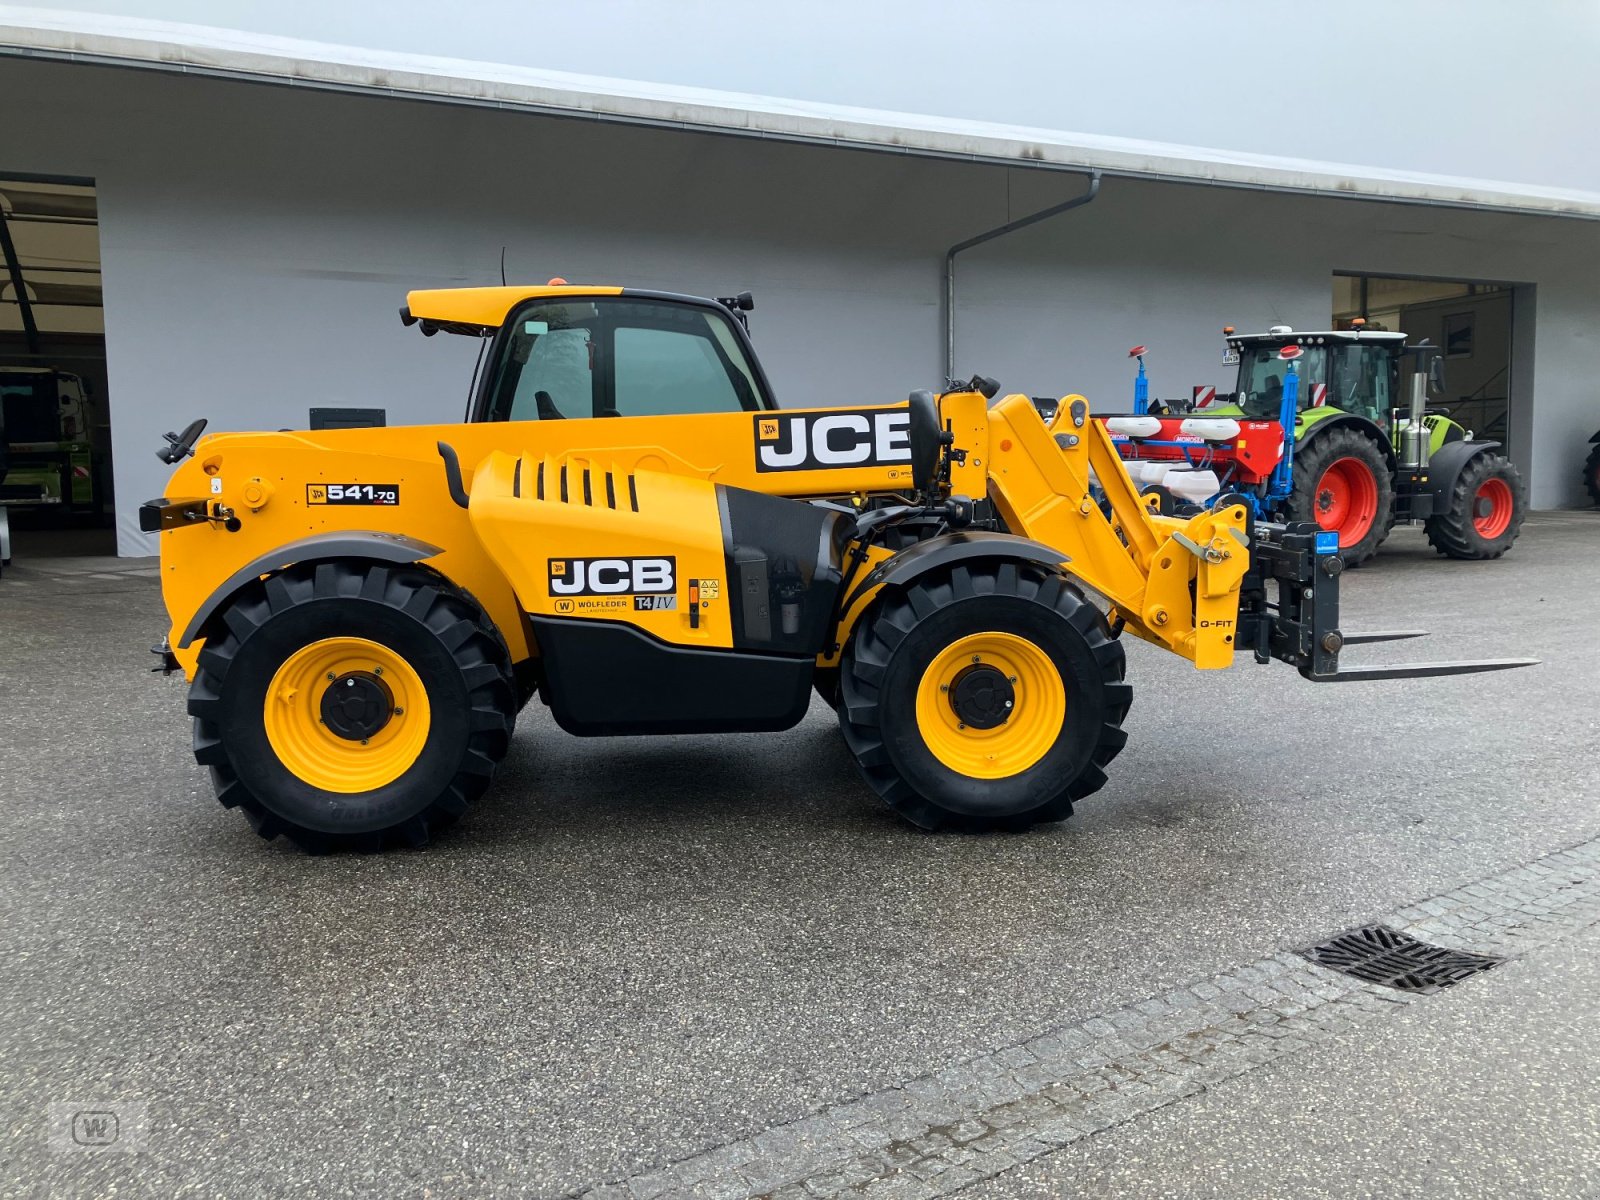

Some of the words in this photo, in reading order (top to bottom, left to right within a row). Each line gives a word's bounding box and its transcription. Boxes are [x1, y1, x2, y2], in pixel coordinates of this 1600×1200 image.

[327, 485, 396, 500] 541-70
[551, 559, 674, 594] JCB
[578, 600, 627, 608] WÖLFLEDER
[636, 597, 652, 609] T4
[1200, 620, 1233, 628] Q-FIT
